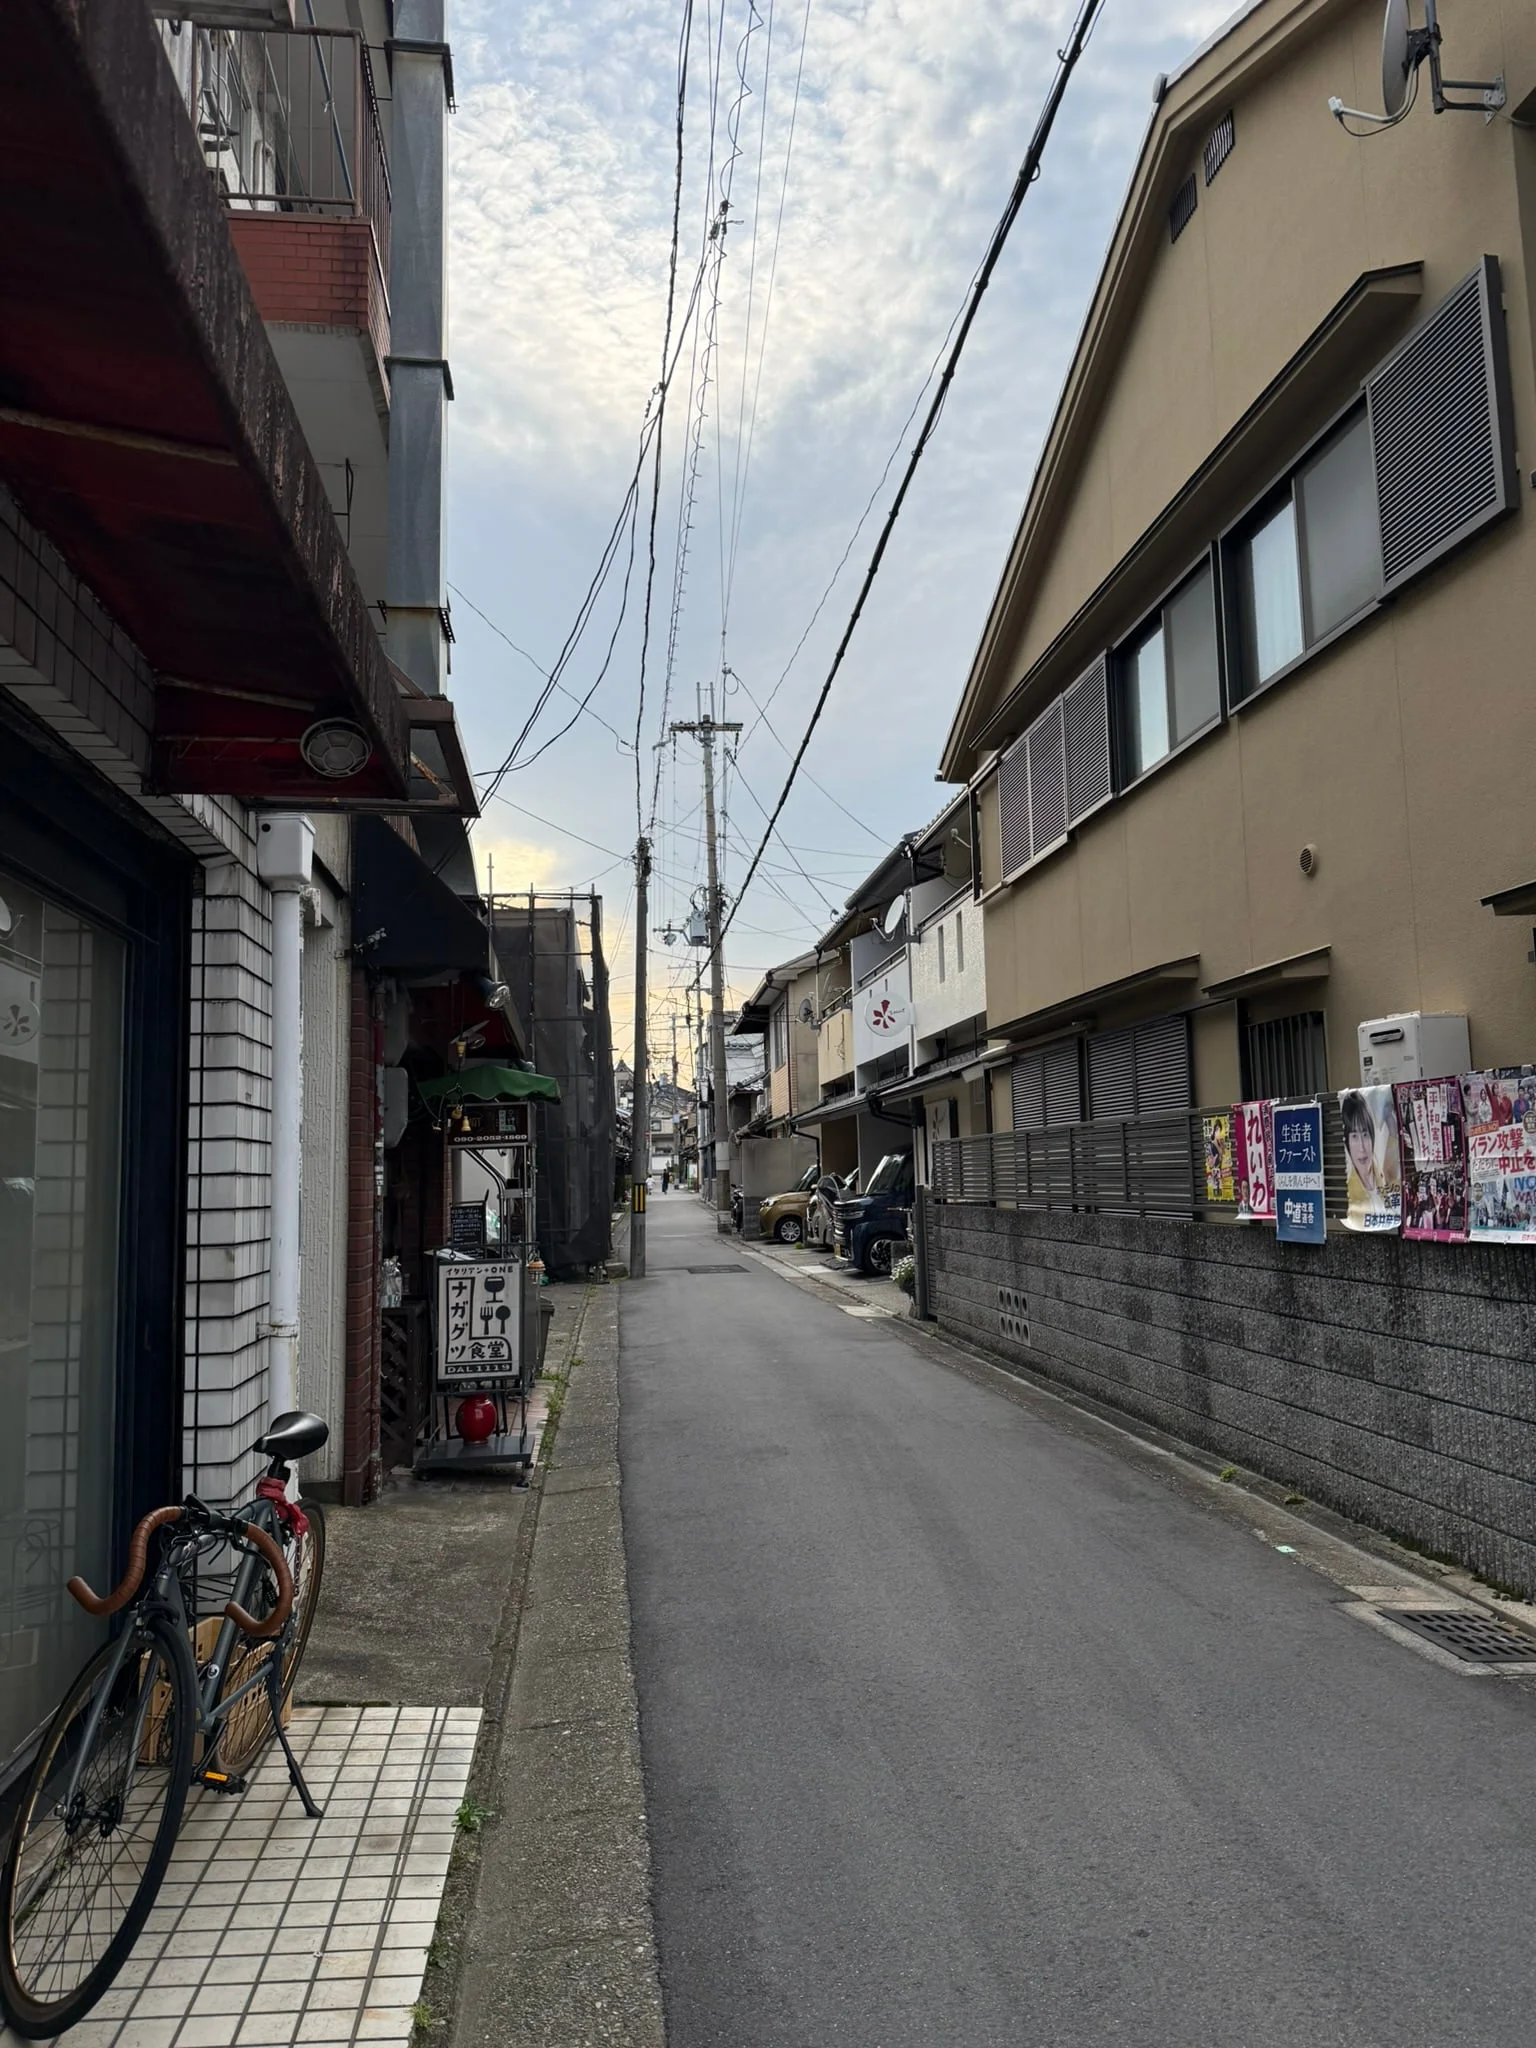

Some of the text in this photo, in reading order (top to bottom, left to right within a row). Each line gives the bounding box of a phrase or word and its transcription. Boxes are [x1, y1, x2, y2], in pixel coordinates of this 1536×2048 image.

[1281, 1122, 1312, 1143] 生活者
[1470, 1127, 1525, 1157] イラン攻撃
[1246, 1109, 1266, 1208] れいわ
[1279, 1145, 1316, 1164] ファースト
[1498, 1149, 1536, 1175] 中止を
[1284, 1198, 1302, 1224] 中道
[468, 1341, 505, 1360] 食堂
